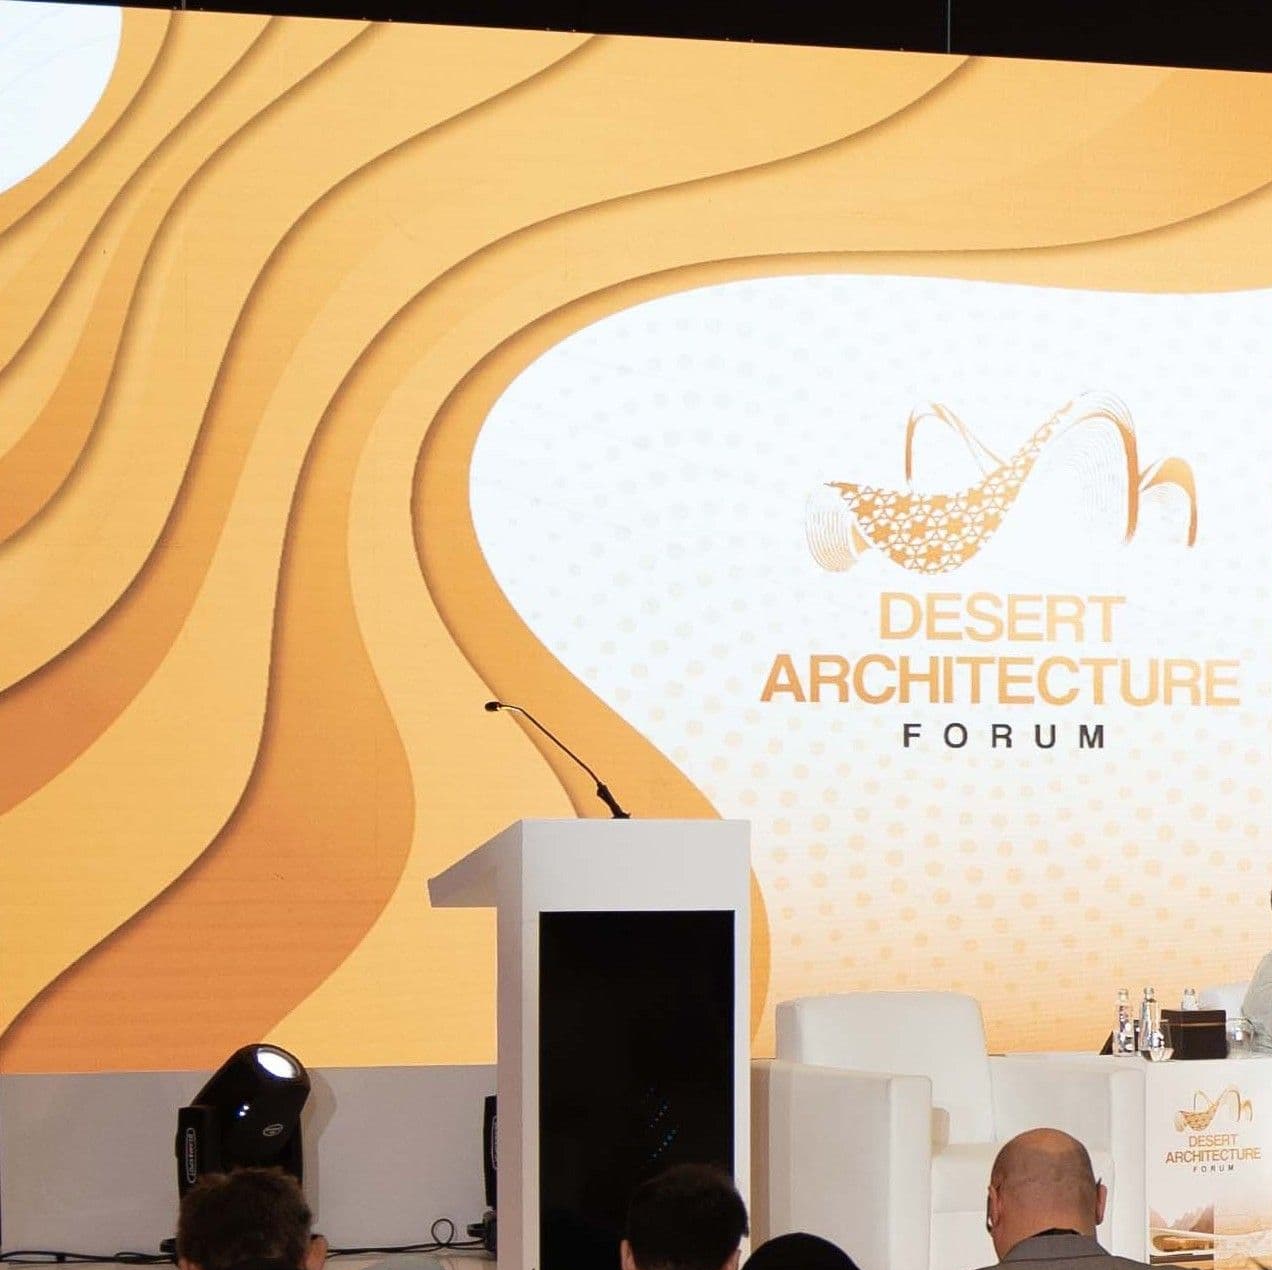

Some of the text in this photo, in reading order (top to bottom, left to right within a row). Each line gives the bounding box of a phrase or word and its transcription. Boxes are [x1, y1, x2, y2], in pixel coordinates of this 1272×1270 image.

[879, 590, 1126, 643] DESERT
[760, 653, 1242, 707] ARCHITECTURE
[902, 722, 1105, 749] FORUM
[1188, 1133, 1238, 1148] DESERT
[1165, 1147, 1262, 1163] ARCHITECTURE
[1193, 1164, 1235, 1173] FORUM
